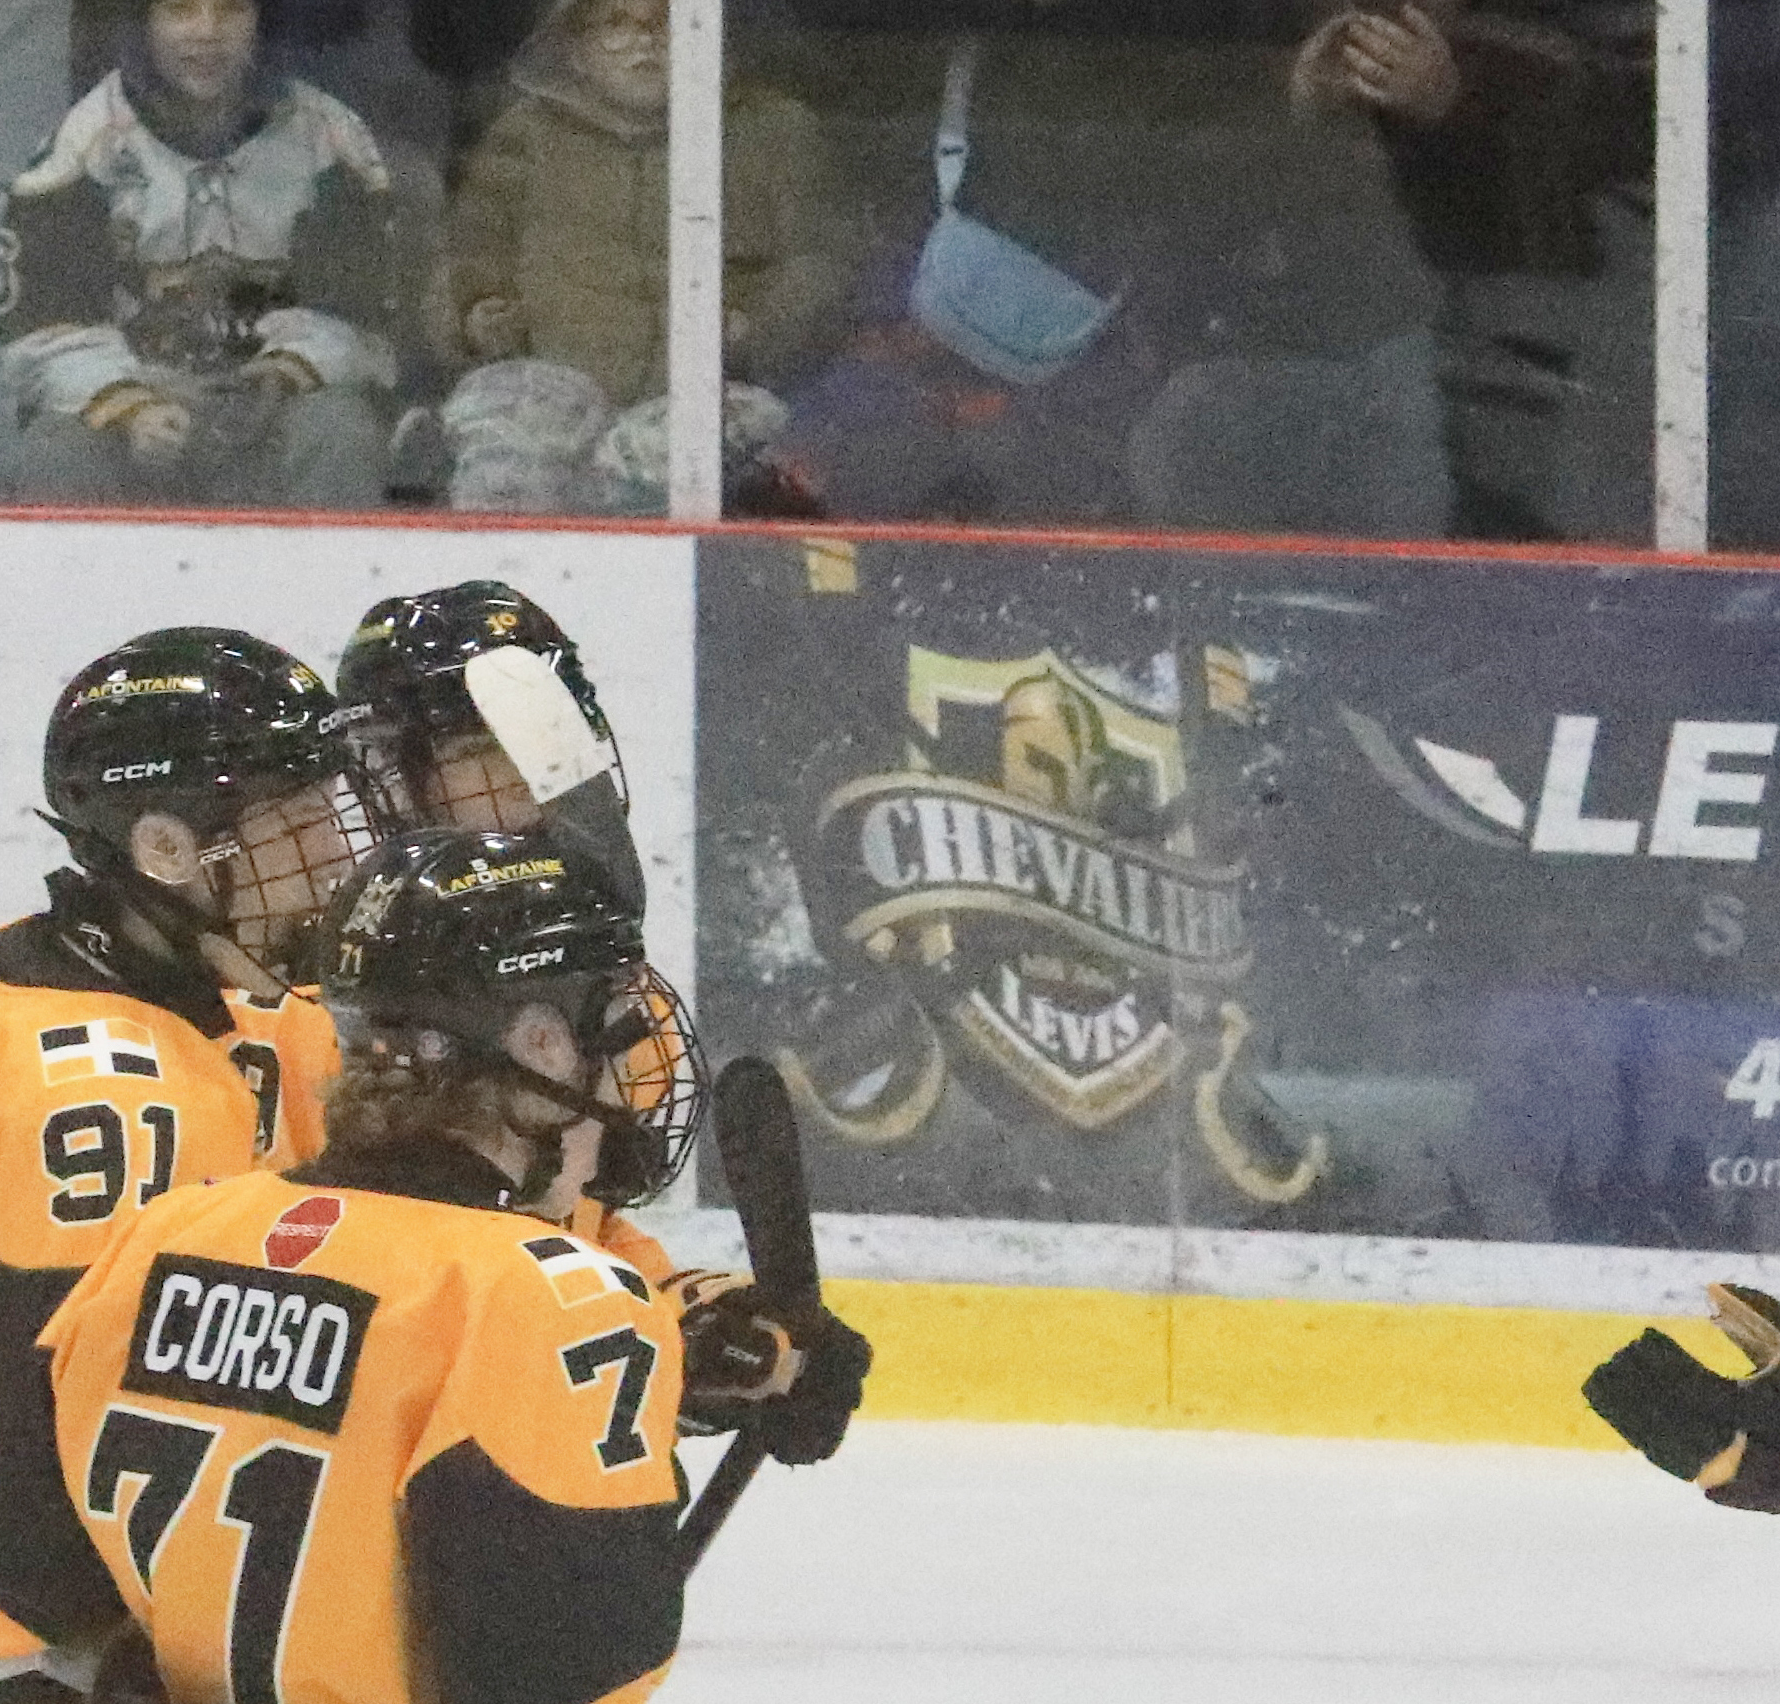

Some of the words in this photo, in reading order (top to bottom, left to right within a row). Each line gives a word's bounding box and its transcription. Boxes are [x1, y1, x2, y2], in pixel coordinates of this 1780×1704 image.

[101, 759, 172, 783] CCM
[496, 947, 565, 975] CCM
[40, 1101, 182, 1227] 91
[143, 1273, 349, 1407] CORSO
[556, 1322, 658, 1478] 7
